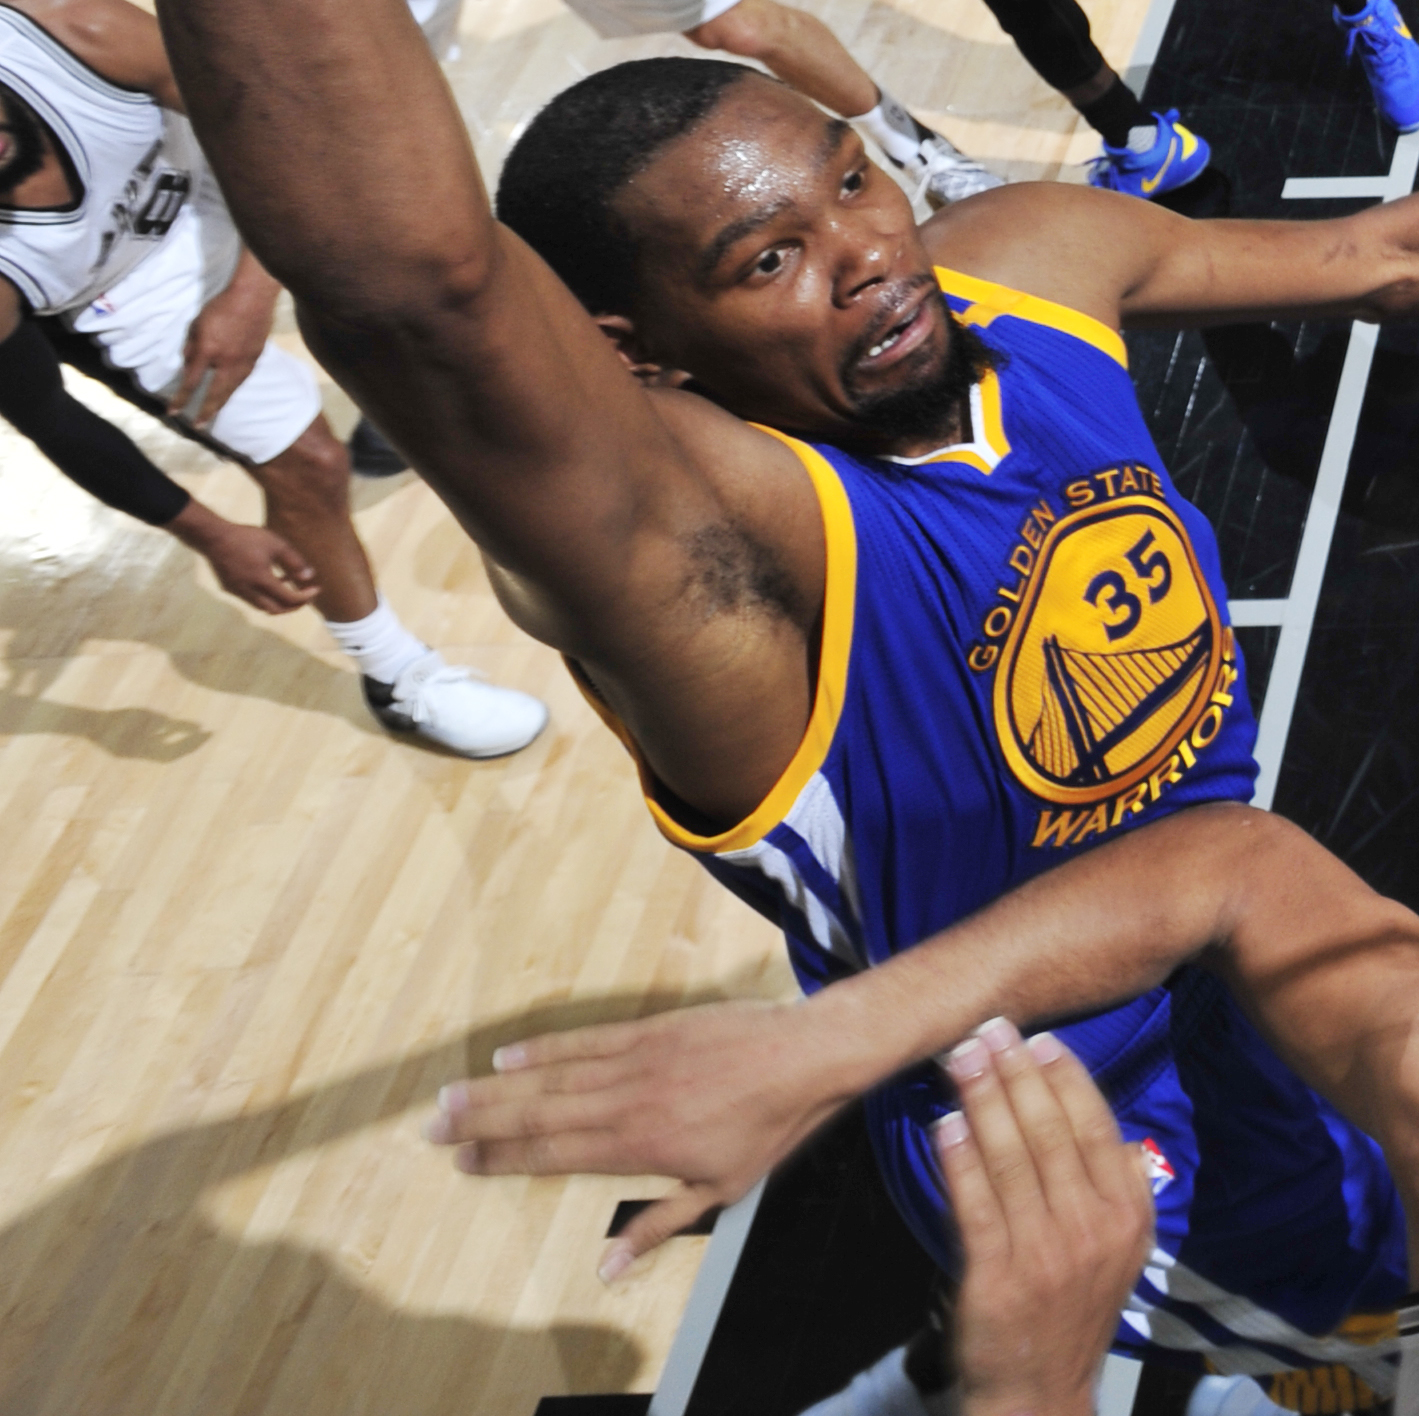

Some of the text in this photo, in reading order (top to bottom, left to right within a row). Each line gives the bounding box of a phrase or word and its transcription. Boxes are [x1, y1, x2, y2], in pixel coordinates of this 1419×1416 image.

[968, 464, 1165, 673] GOLDEN STATE
[1082, 526, 1173, 643] 35
